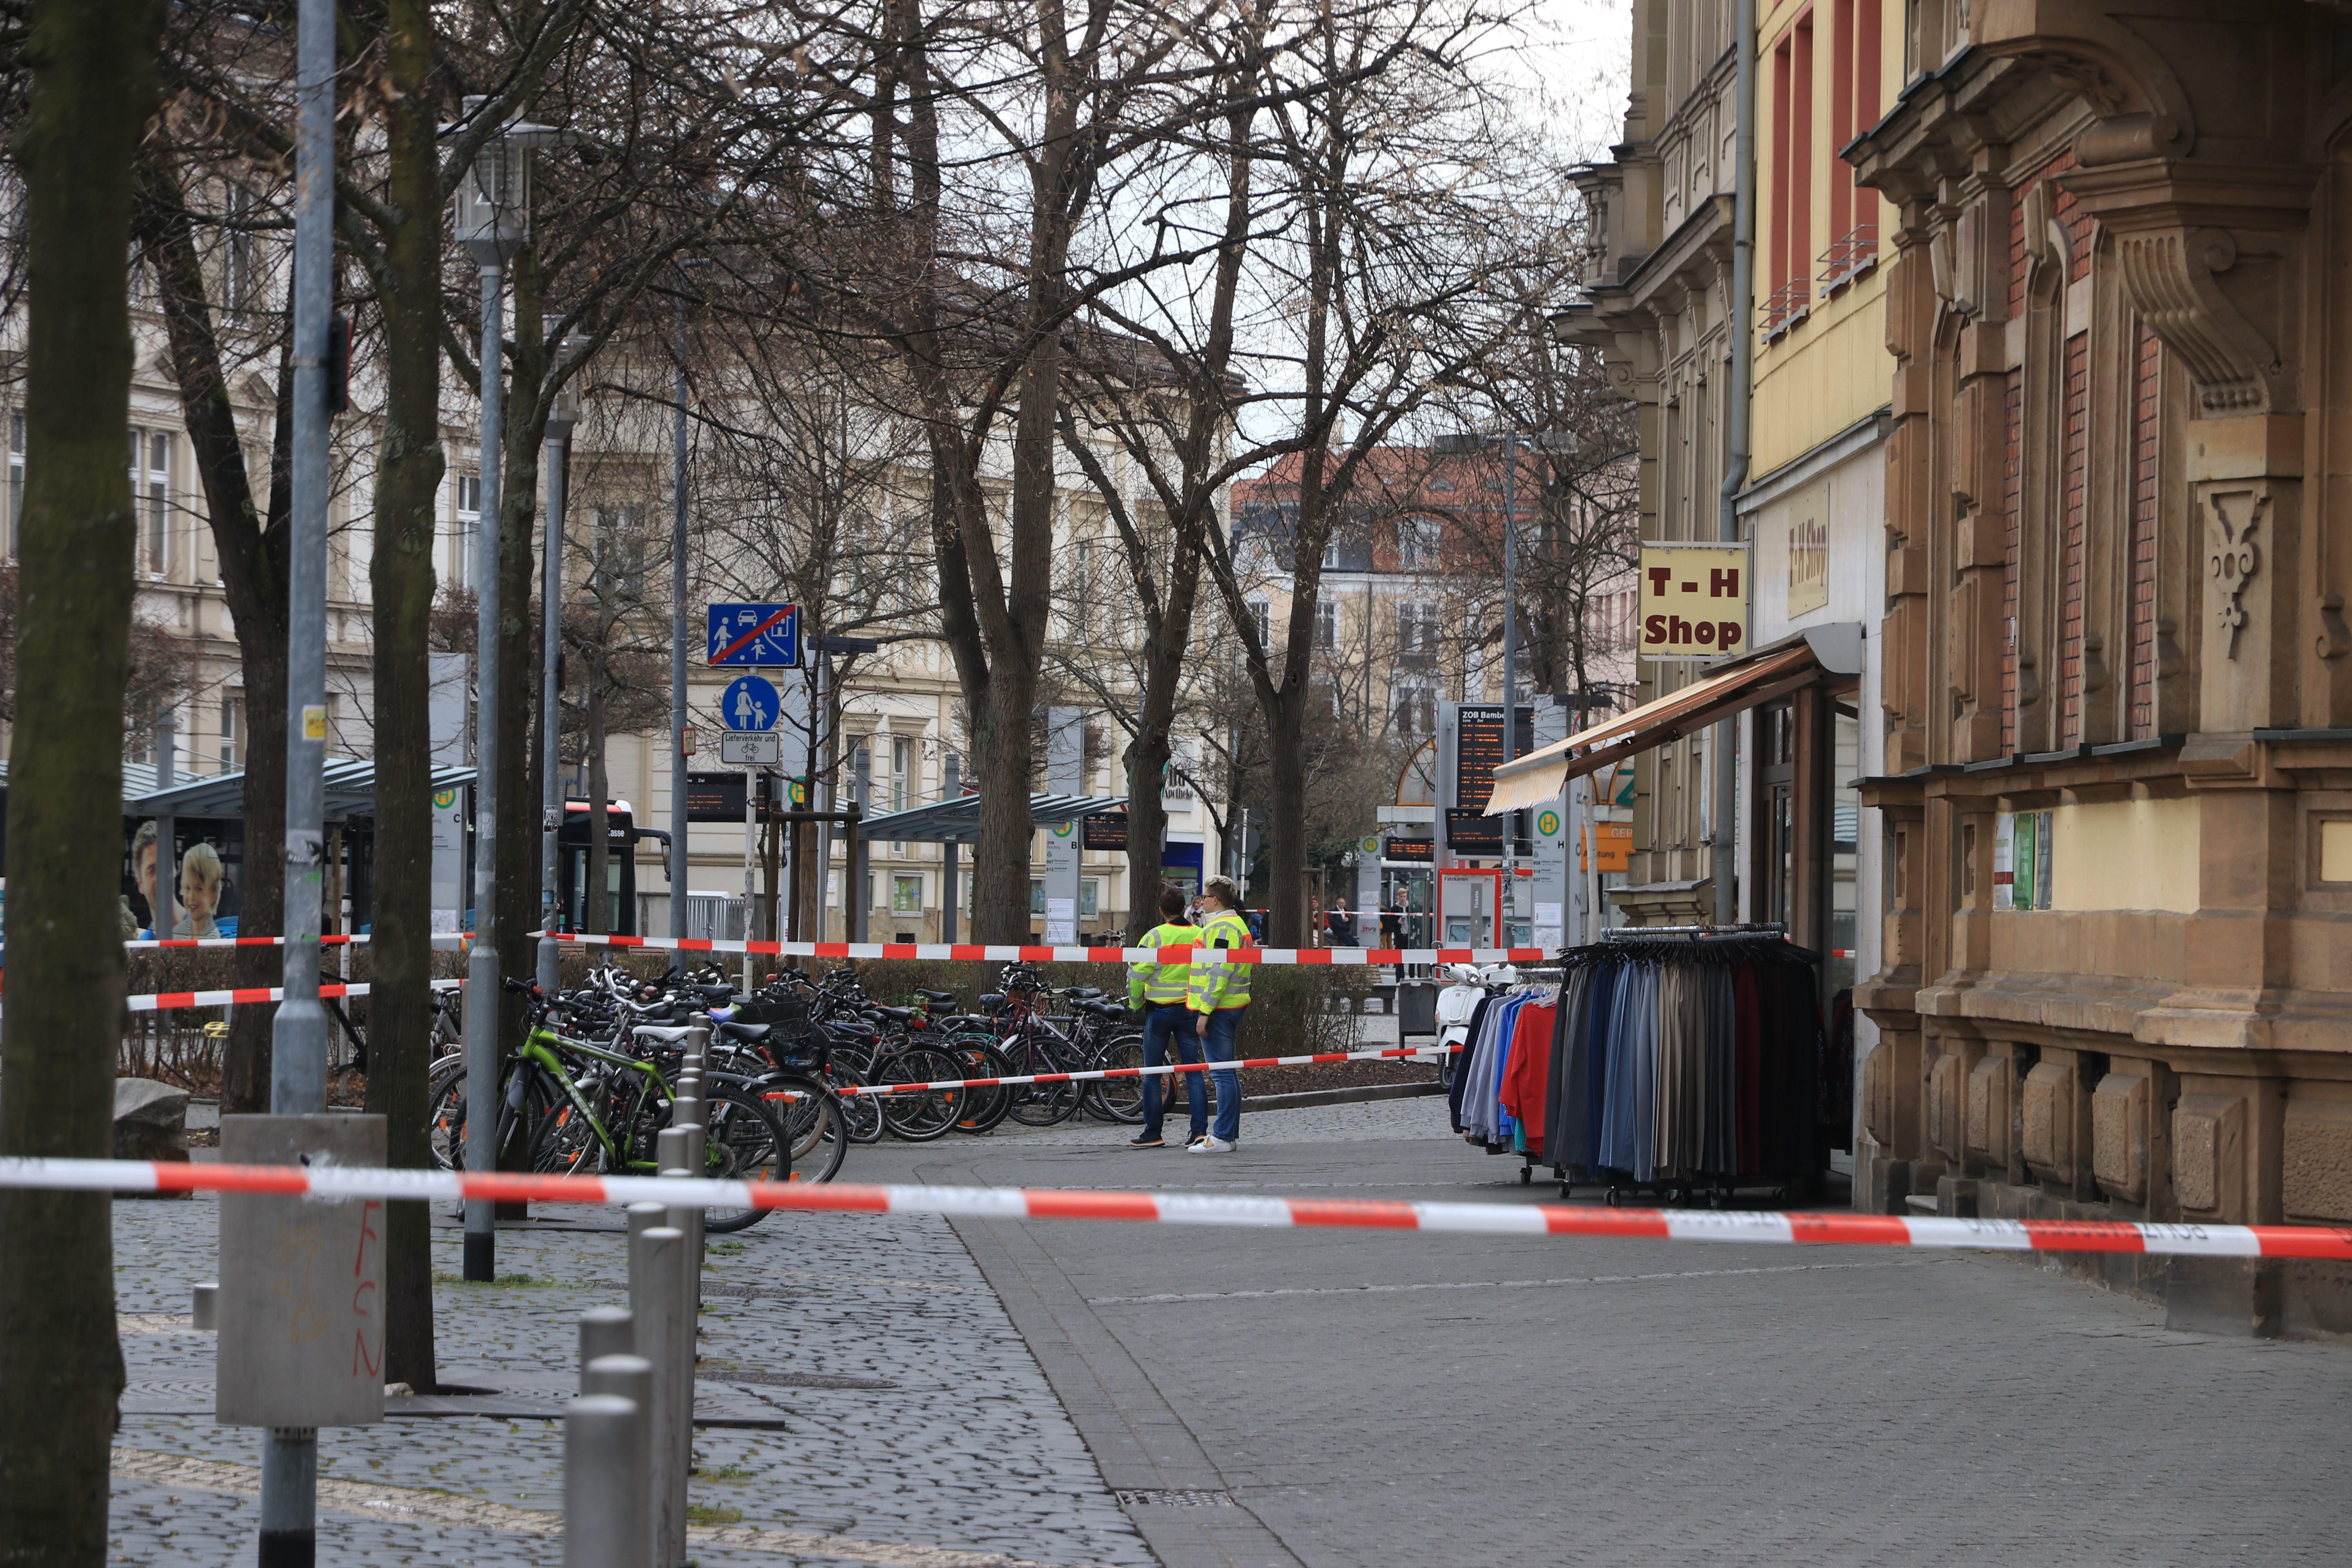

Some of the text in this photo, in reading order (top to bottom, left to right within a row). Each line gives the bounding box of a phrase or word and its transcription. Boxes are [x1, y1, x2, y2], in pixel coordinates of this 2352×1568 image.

[1806, 517, 1826, 587] Shop
[1644, 615, 1742, 651] Shop
[725, 733, 763, 742] Lieferverkehr
[1165, 787, 1193, 800] Apotheke
[454, 813, 461, 823] C
[608, 828, 624, 837] asse
[1558, 840, 1564, 849] H
[1584, 850, 1615, 859] Atung
